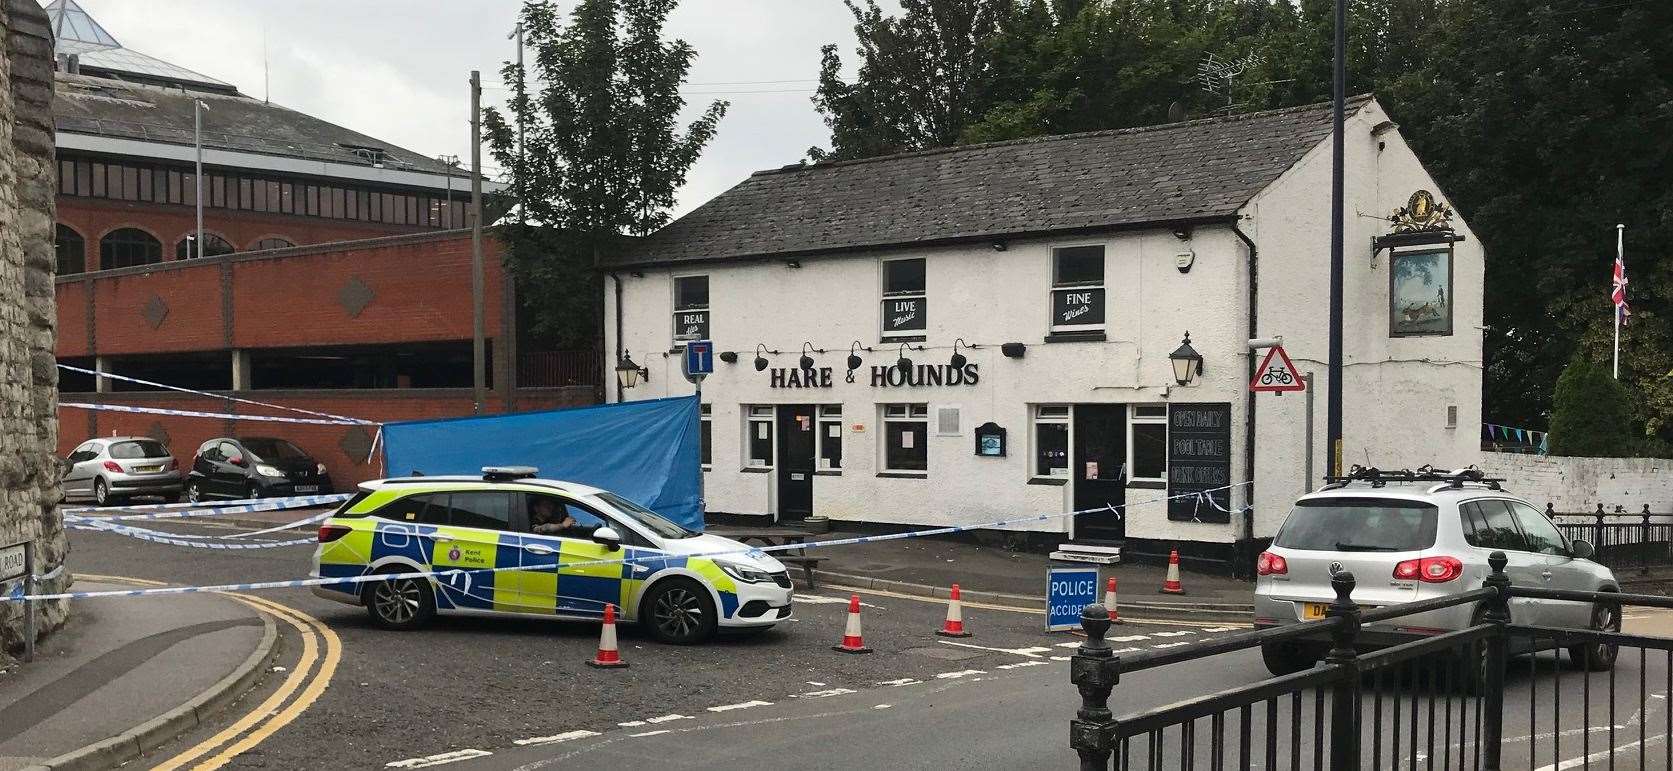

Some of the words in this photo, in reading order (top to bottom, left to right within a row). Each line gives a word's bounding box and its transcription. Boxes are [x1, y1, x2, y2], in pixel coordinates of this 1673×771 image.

[895, 301, 916, 312] LIVE
[1066, 292, 1092, 305] FINE
[684, 314, 704, 325] REAL
[893, 312, 916, 328] Music
[1062, 304, 1090, 321] Wines
[769, 366, 832, 390] HARE
[845, 368, 855, 384] &
[870, 362, 980, 388] HOUNDS
[1173, 410, 1196, 428] OPEN
[1196, 409, 1224, 427] DAILY
[1173, 438, 1195, 456] POOL
[5, 552, 24, 570] ROAD
[464, 556, 485, 565] Police
[1051, 580, 1093, 596] POLICE
[1050, 604, 1085, 616] ACCIDE
